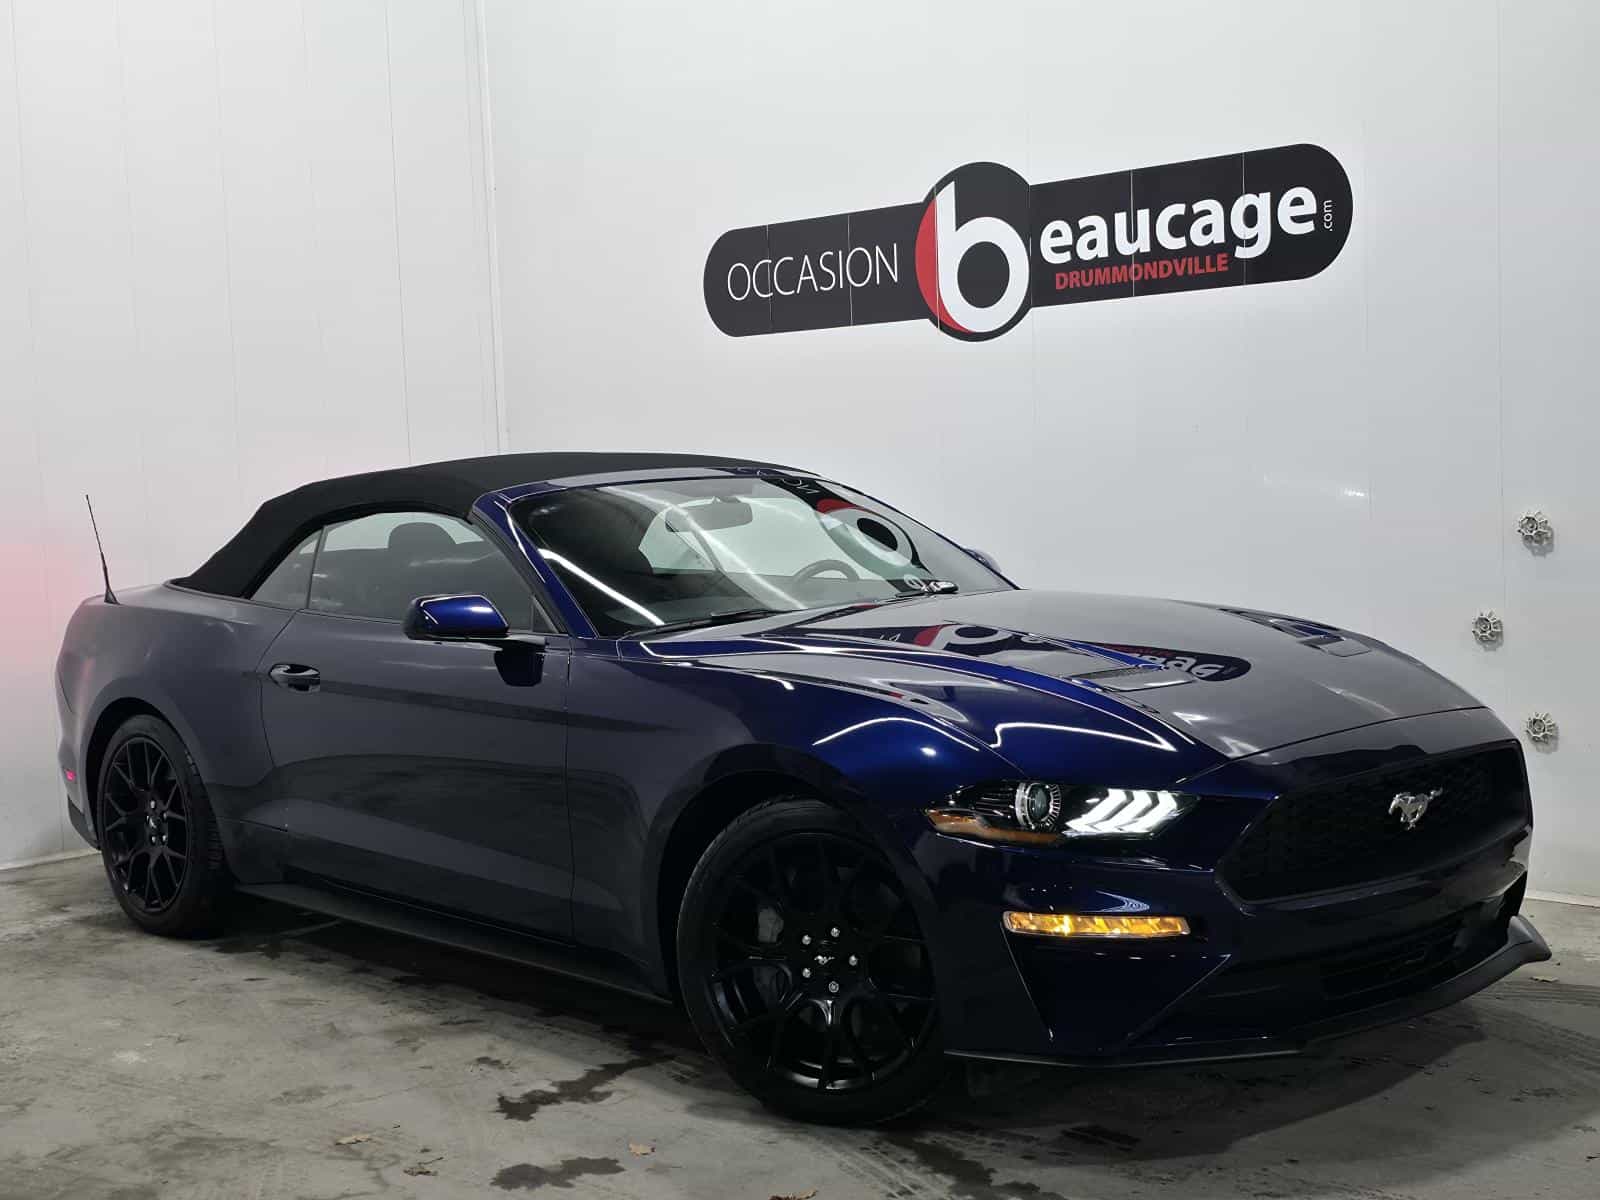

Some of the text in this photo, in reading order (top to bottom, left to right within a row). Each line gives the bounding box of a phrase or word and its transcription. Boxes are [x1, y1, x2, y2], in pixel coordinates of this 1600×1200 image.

[727, 242, 899, 301] OCCASION
[1322, 199, 1334, 232] .com
[1055, 253, 1228, 290] DRUMMONDVILLE
